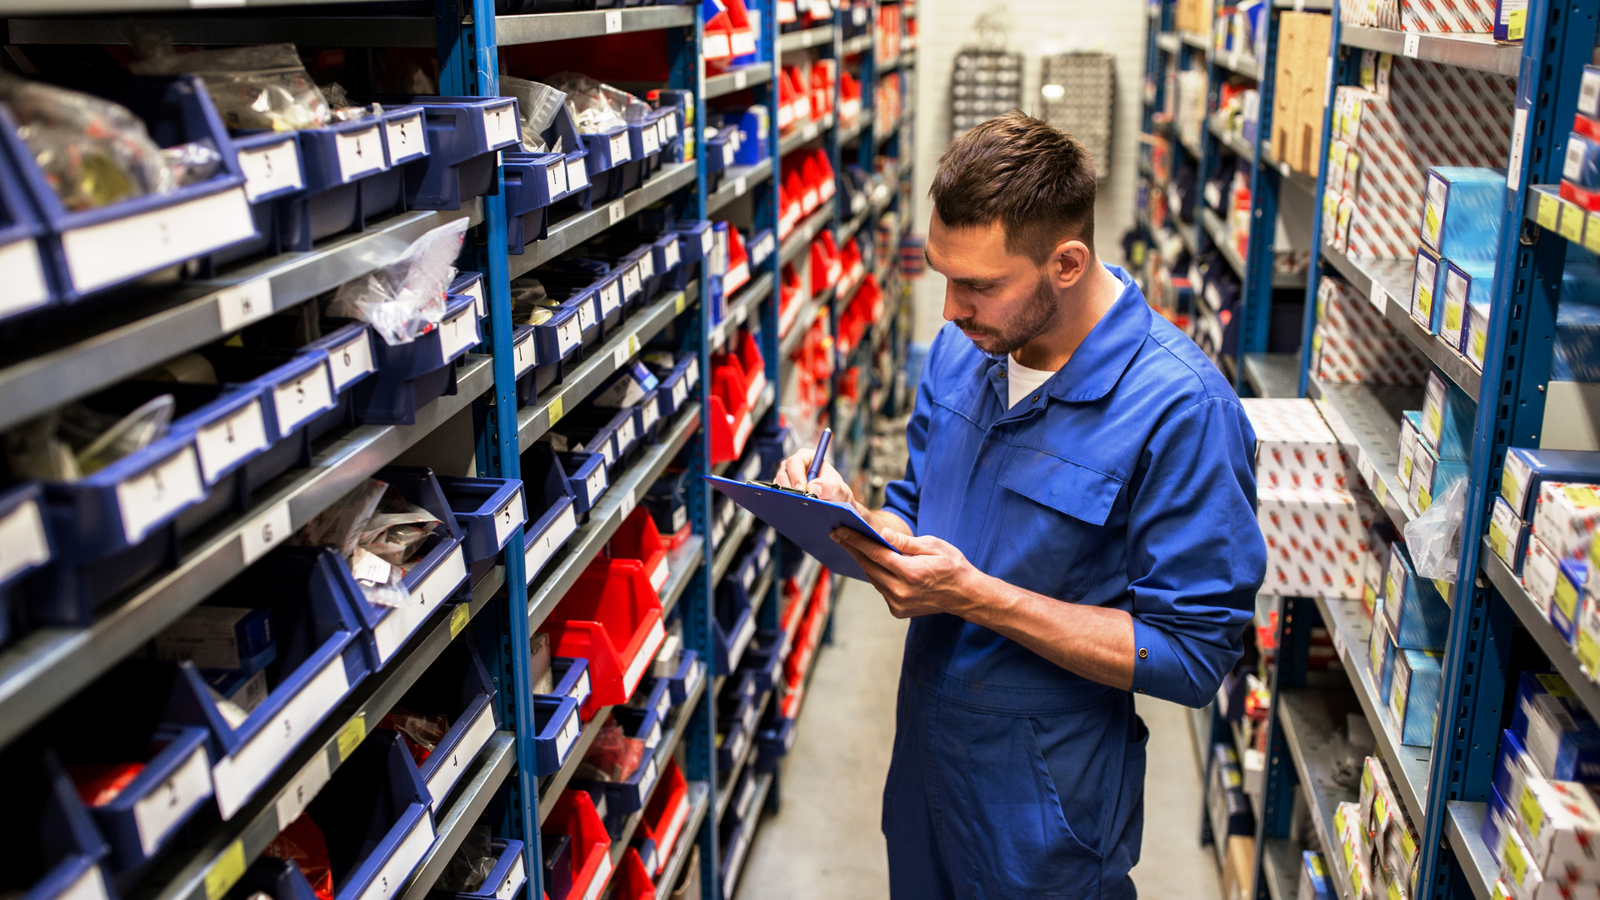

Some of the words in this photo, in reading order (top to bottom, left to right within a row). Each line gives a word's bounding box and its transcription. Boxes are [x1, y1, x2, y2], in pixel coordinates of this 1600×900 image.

[552, 168, 557, 185] 1
[343, 346, 351, 367] 6
[518, 346, 523, 361] 1
[504, 505, 511, 524] 5
[420, 592, 426, 606] 4
[564, 726, 569, 739] 1
[453, 755, 458, 767] 4
